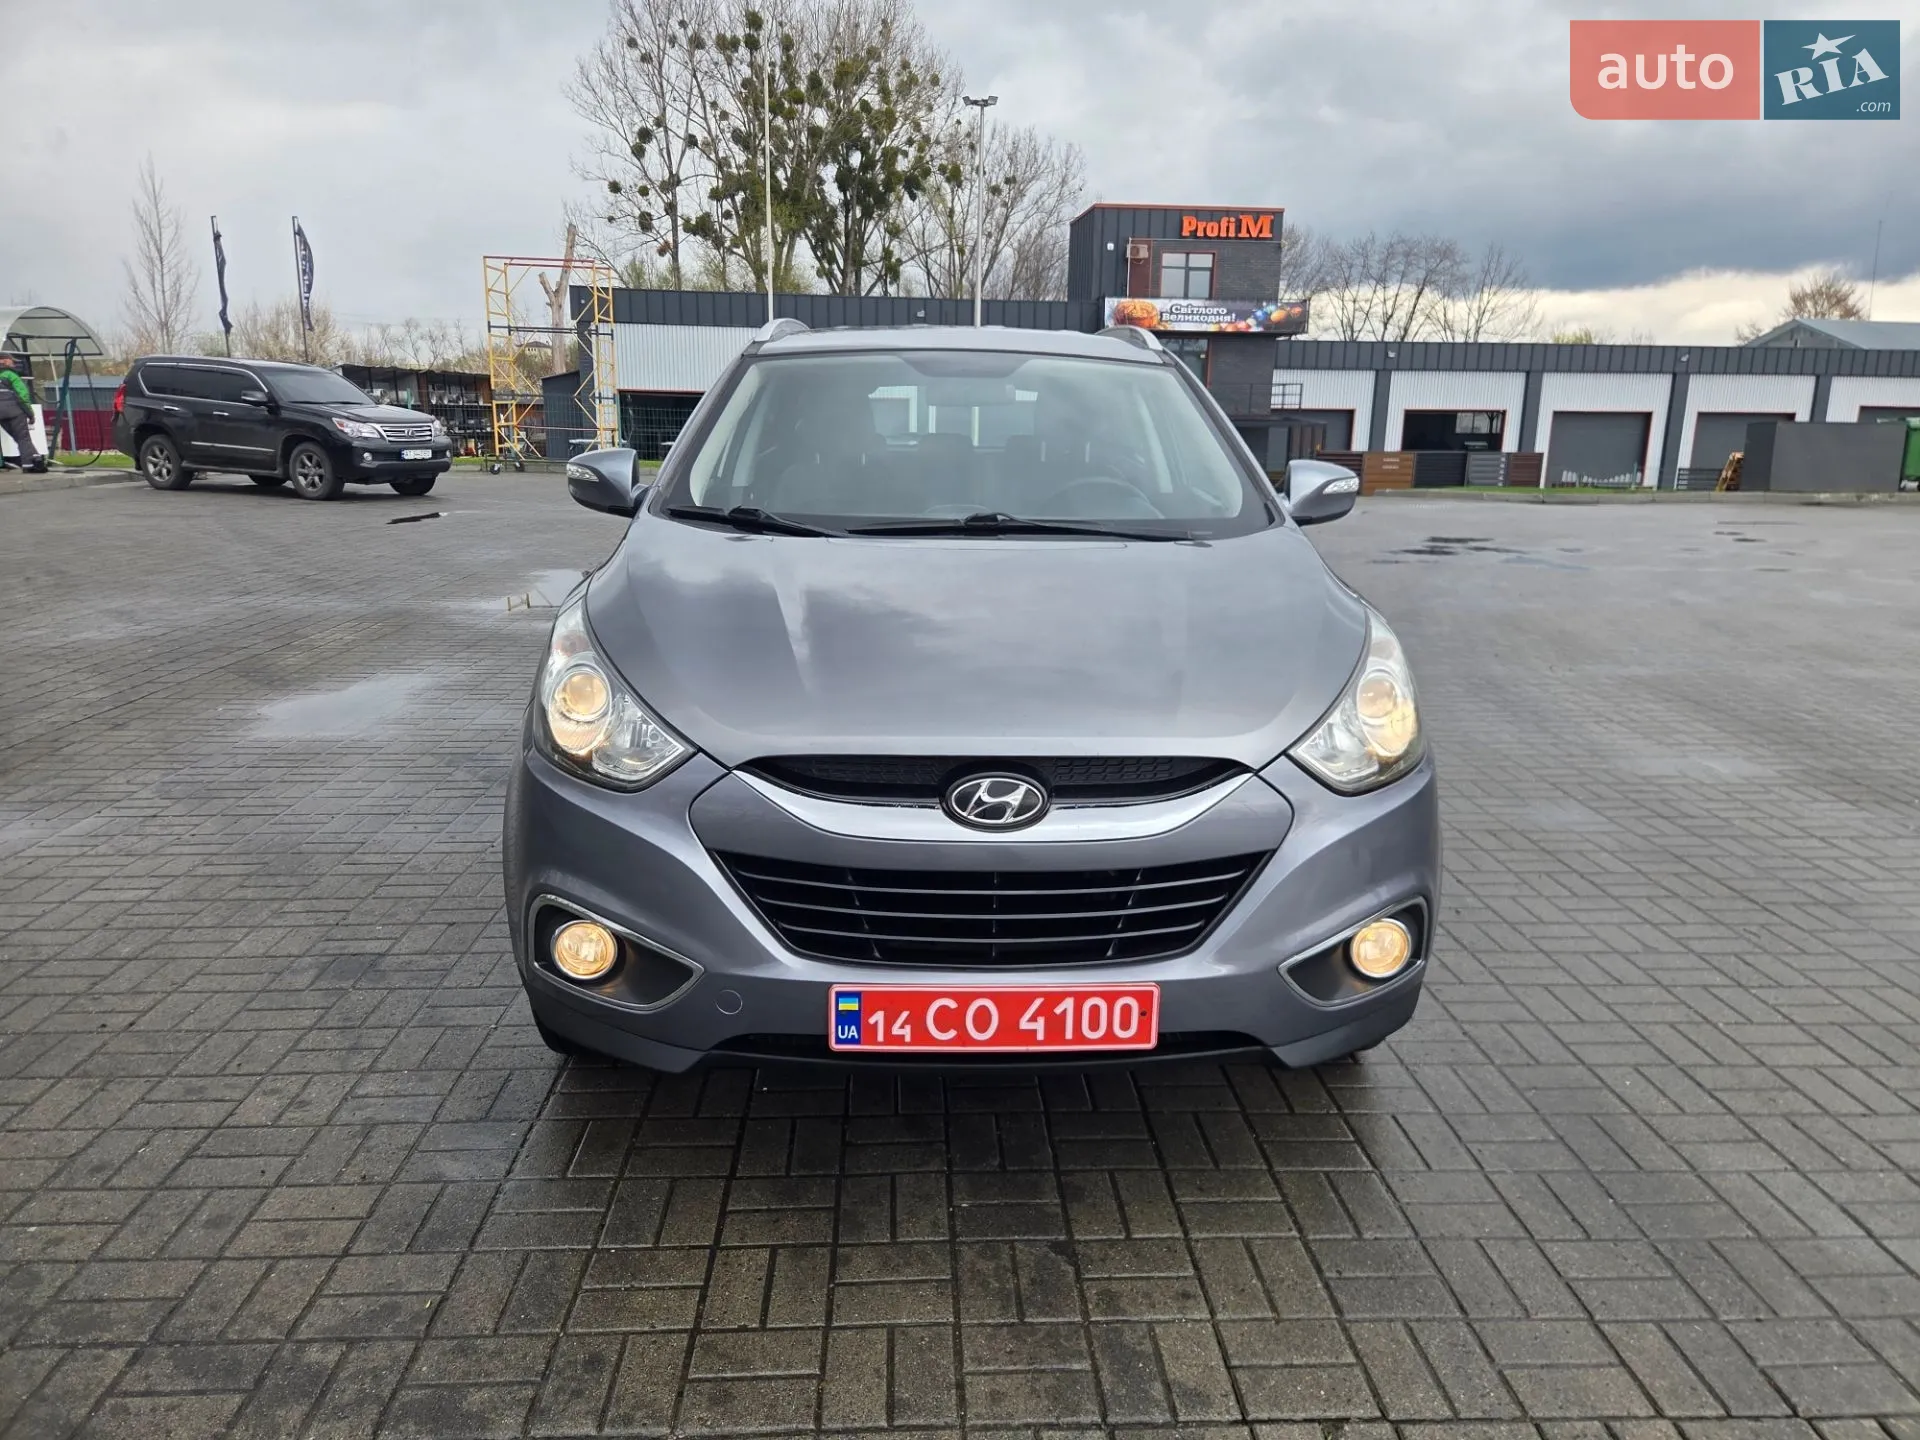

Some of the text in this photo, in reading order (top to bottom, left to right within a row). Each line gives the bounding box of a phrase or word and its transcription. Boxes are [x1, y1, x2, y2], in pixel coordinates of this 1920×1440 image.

[1171, 304, 1227, 315] Світлого
[1161, 312, 1236, 323] Великодня!
[867, 996, 1140, 1042] 14 CO 4100
[837, 1025, 858, 1039] UA
